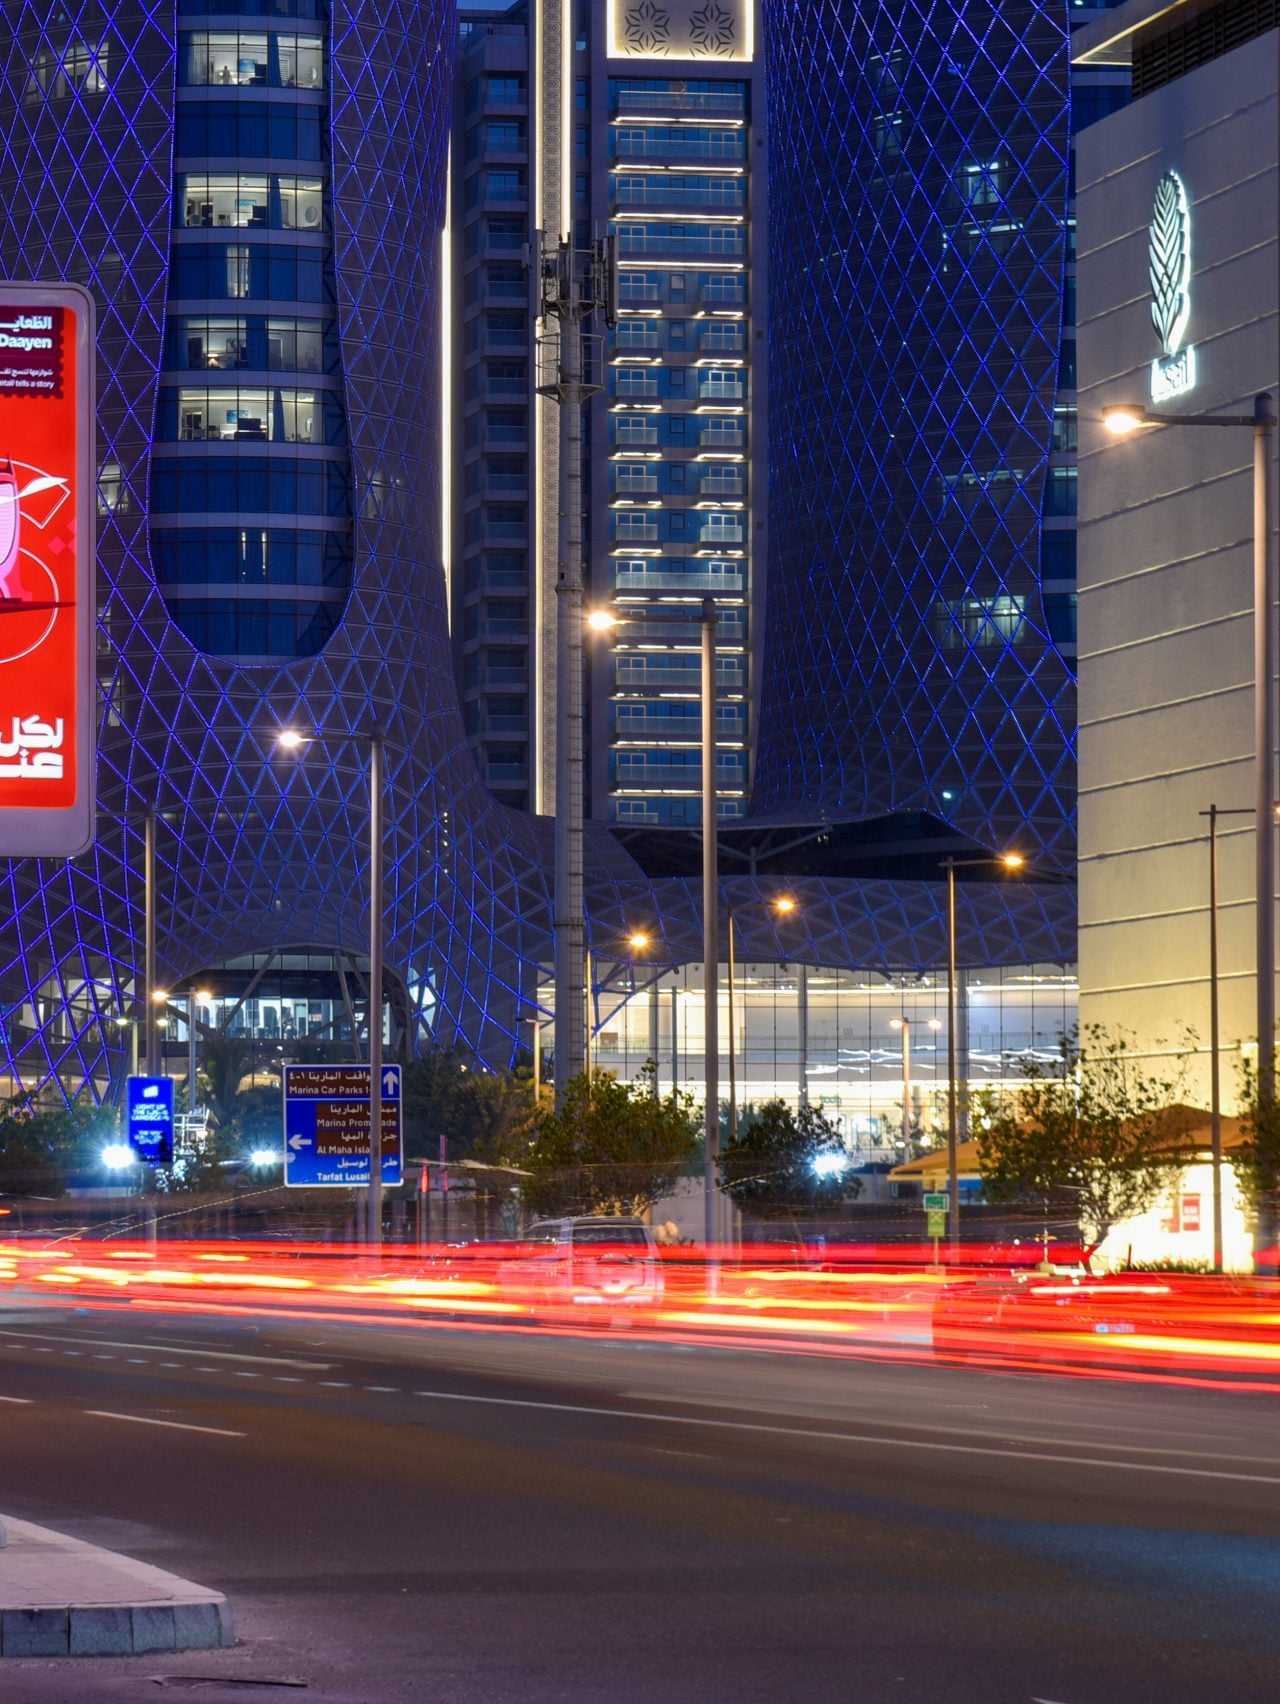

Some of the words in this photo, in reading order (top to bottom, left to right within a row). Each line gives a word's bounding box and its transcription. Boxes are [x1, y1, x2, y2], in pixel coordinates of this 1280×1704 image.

[15, 379, 29, 388] tells
[36, 381, 55, 390] story
[308, 1071, 341, 1082] المارينا
[345, 1070, 371, 1081] واقف
[289, 1086, 319, 1094] Marina
[321, 1086, 336, 1094] Car
[339, 1086, 363, 1094] Parks
[330, 1104, 363, 1115] المارينا
[317, 1119, 347, 1127] Marina
[349, 1119, 397, 1127] Promade
[341, 1131, 364, 1142] المها
[317, 1146, 327, 1154] Al
[329, 1146, 352, 1154] Maha
[354, 1146, 371, 1154] Isla
[337, 1158, 368, 1168] لوسيل
[317, 1173, 343, 1181] Tarfat
[345, 1172, 371, 1181] Lusail
